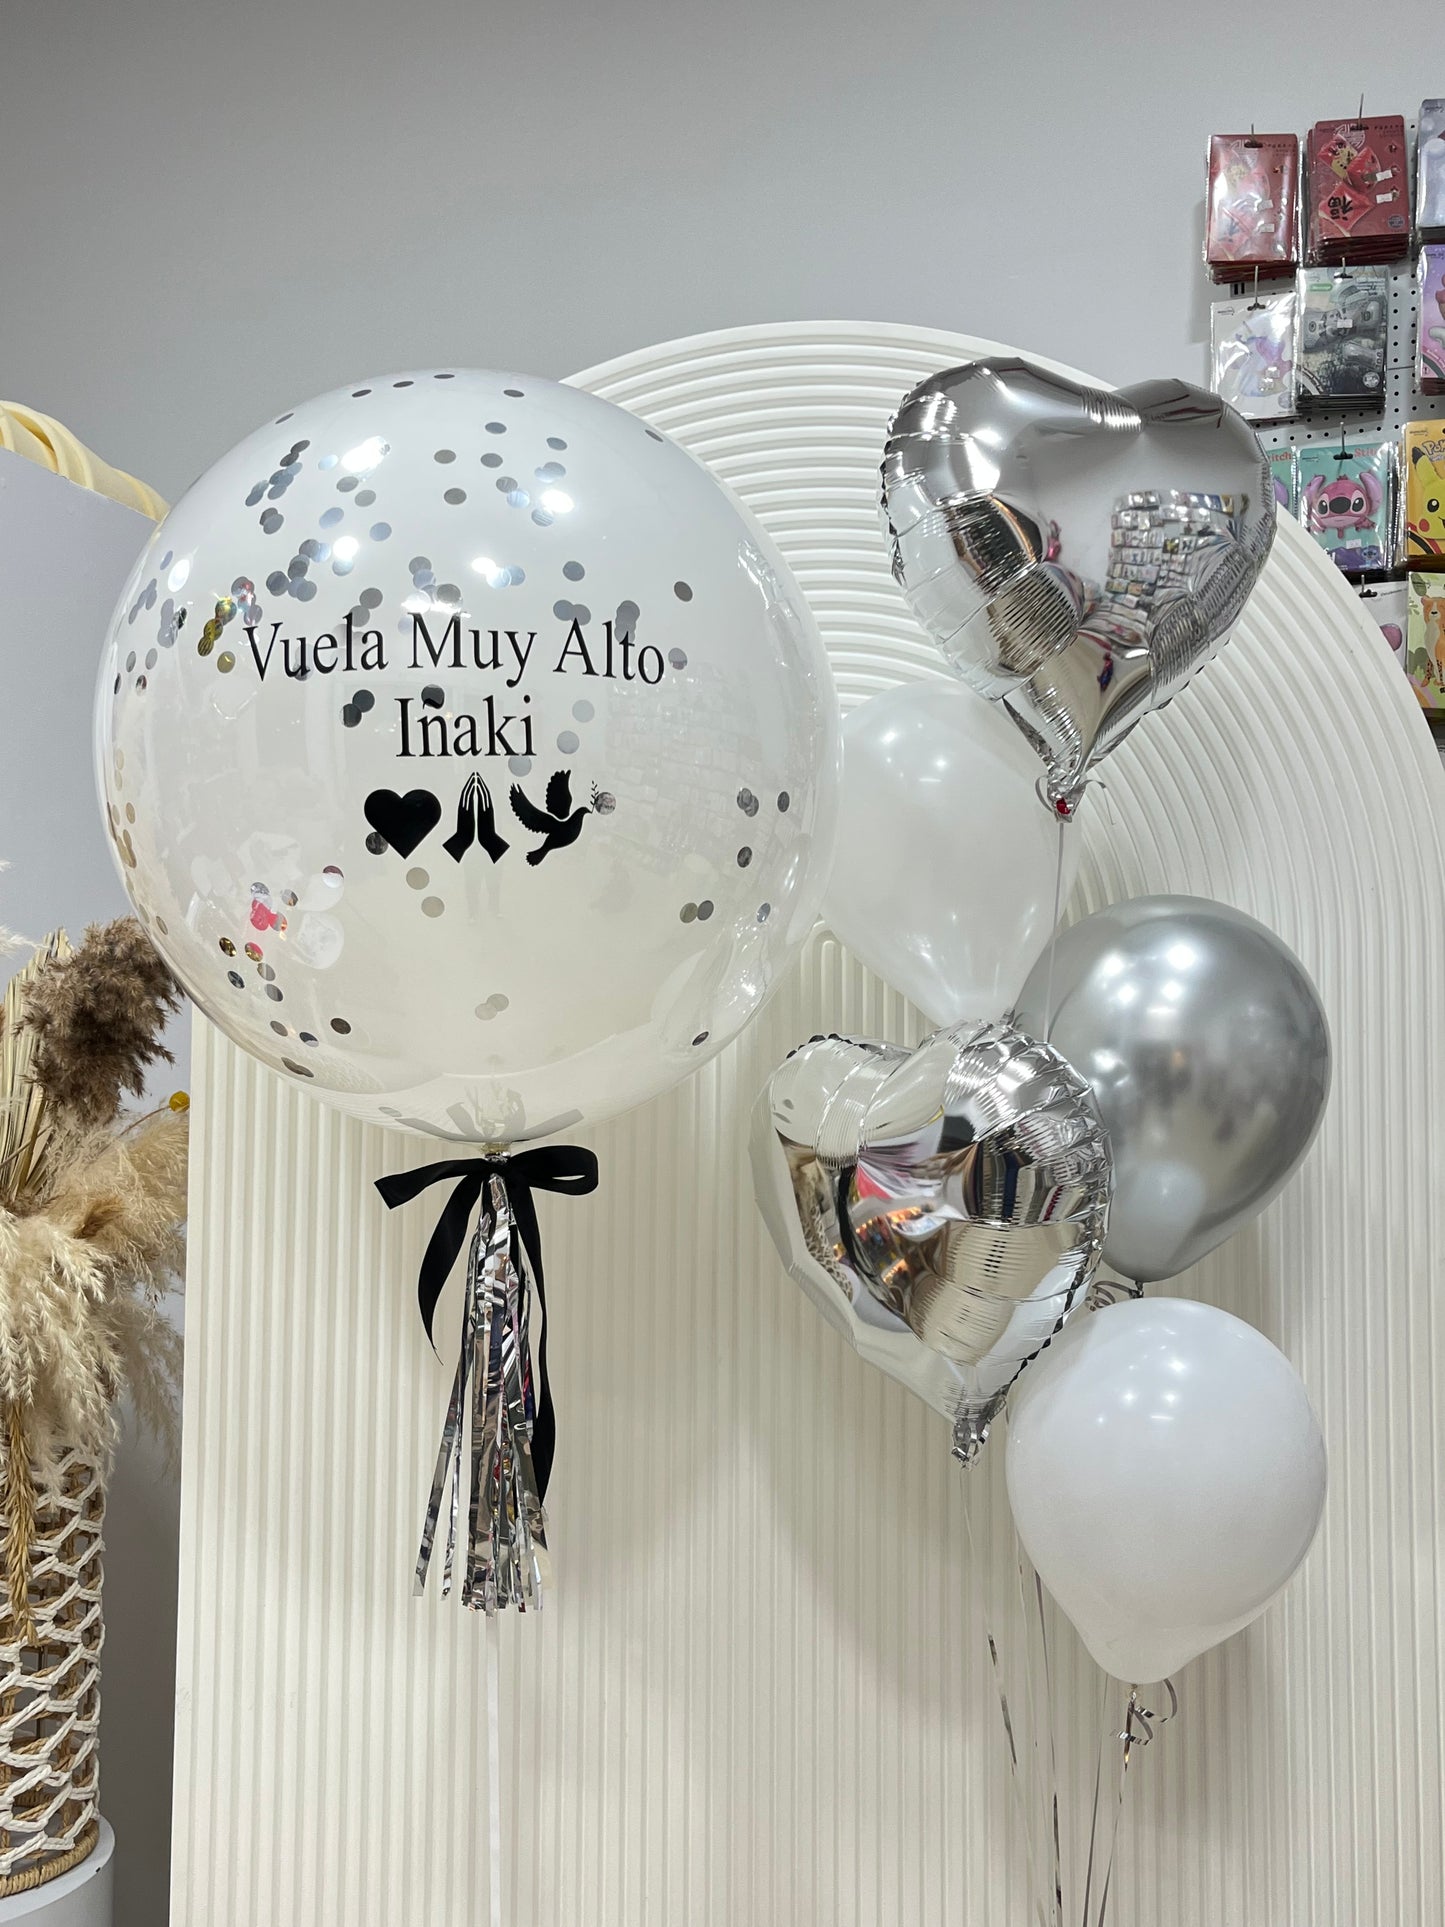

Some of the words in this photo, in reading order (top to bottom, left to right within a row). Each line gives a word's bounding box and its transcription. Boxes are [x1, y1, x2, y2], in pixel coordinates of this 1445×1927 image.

[243, 612, 389, 682] Vuela
[407, 612, 538, 688] Muy
[553, 617, 666, 685] Alto
[395, 694, 538, 758] Iñaki
